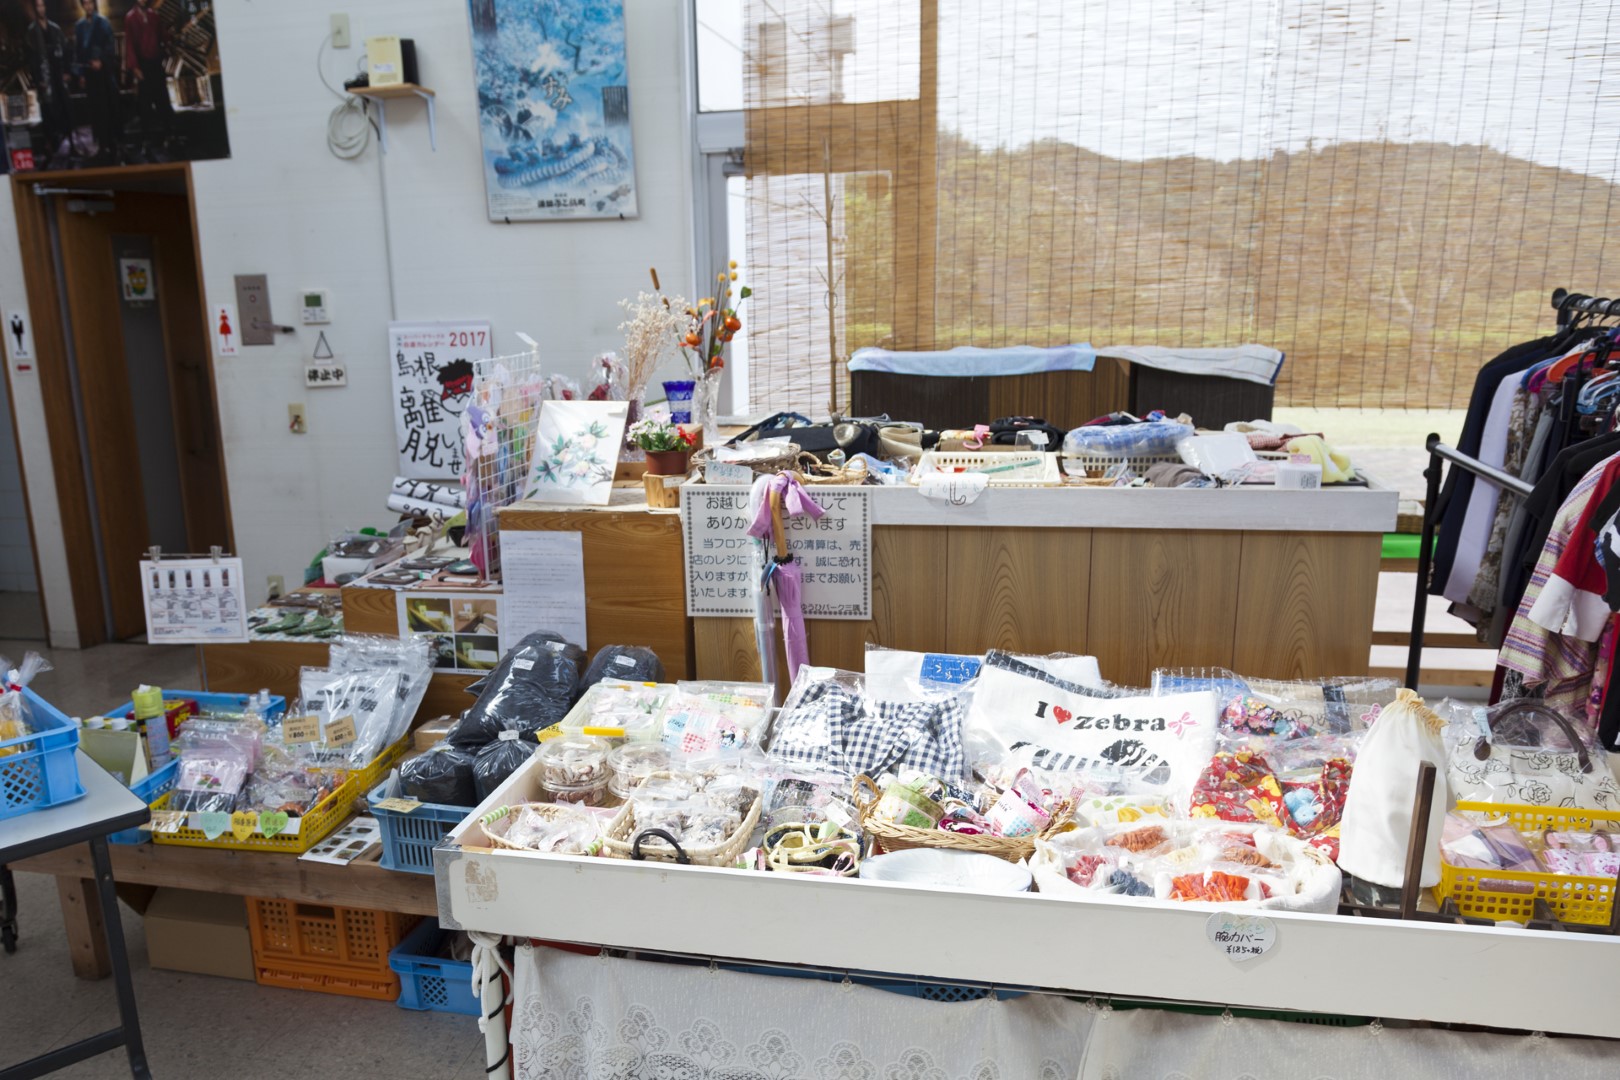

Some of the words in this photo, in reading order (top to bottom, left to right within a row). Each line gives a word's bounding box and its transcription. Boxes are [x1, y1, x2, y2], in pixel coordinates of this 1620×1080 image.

[449, 331, 486, 347] 2017
[1034, 701, 1049, 719] I
[1073, 713, 1166, 732] zebra
[1214, 931, 1265, 943] 腕カバー
